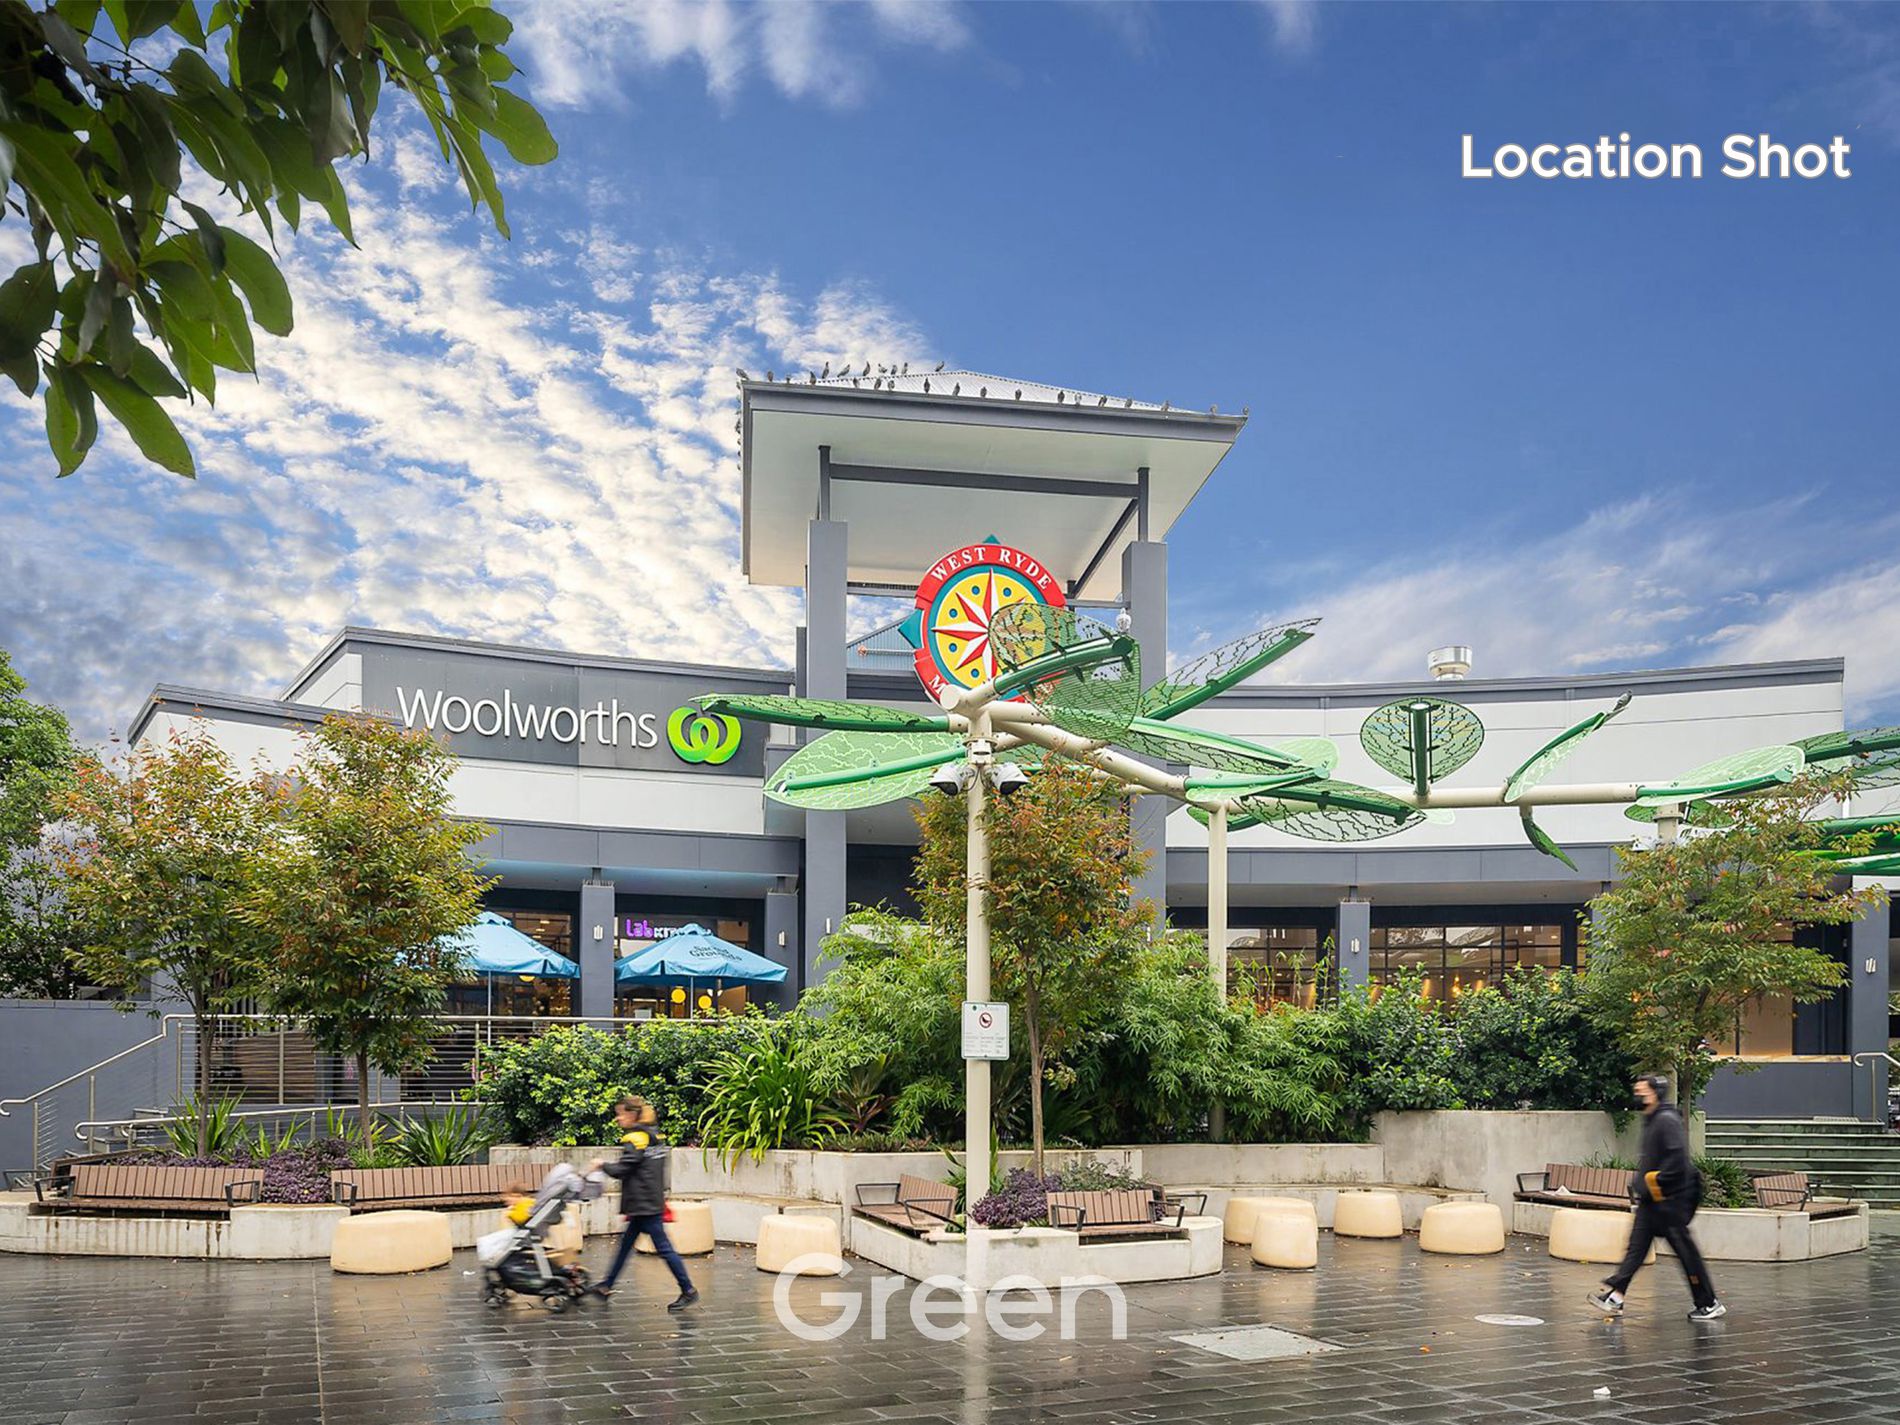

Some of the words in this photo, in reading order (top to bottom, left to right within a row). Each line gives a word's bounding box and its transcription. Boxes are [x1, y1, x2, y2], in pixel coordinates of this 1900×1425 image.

[931, 547, 986, 582] WEST
[1000, 548, 1052, 590] RYDE
[396, 687, 658, 749] Woolworths
